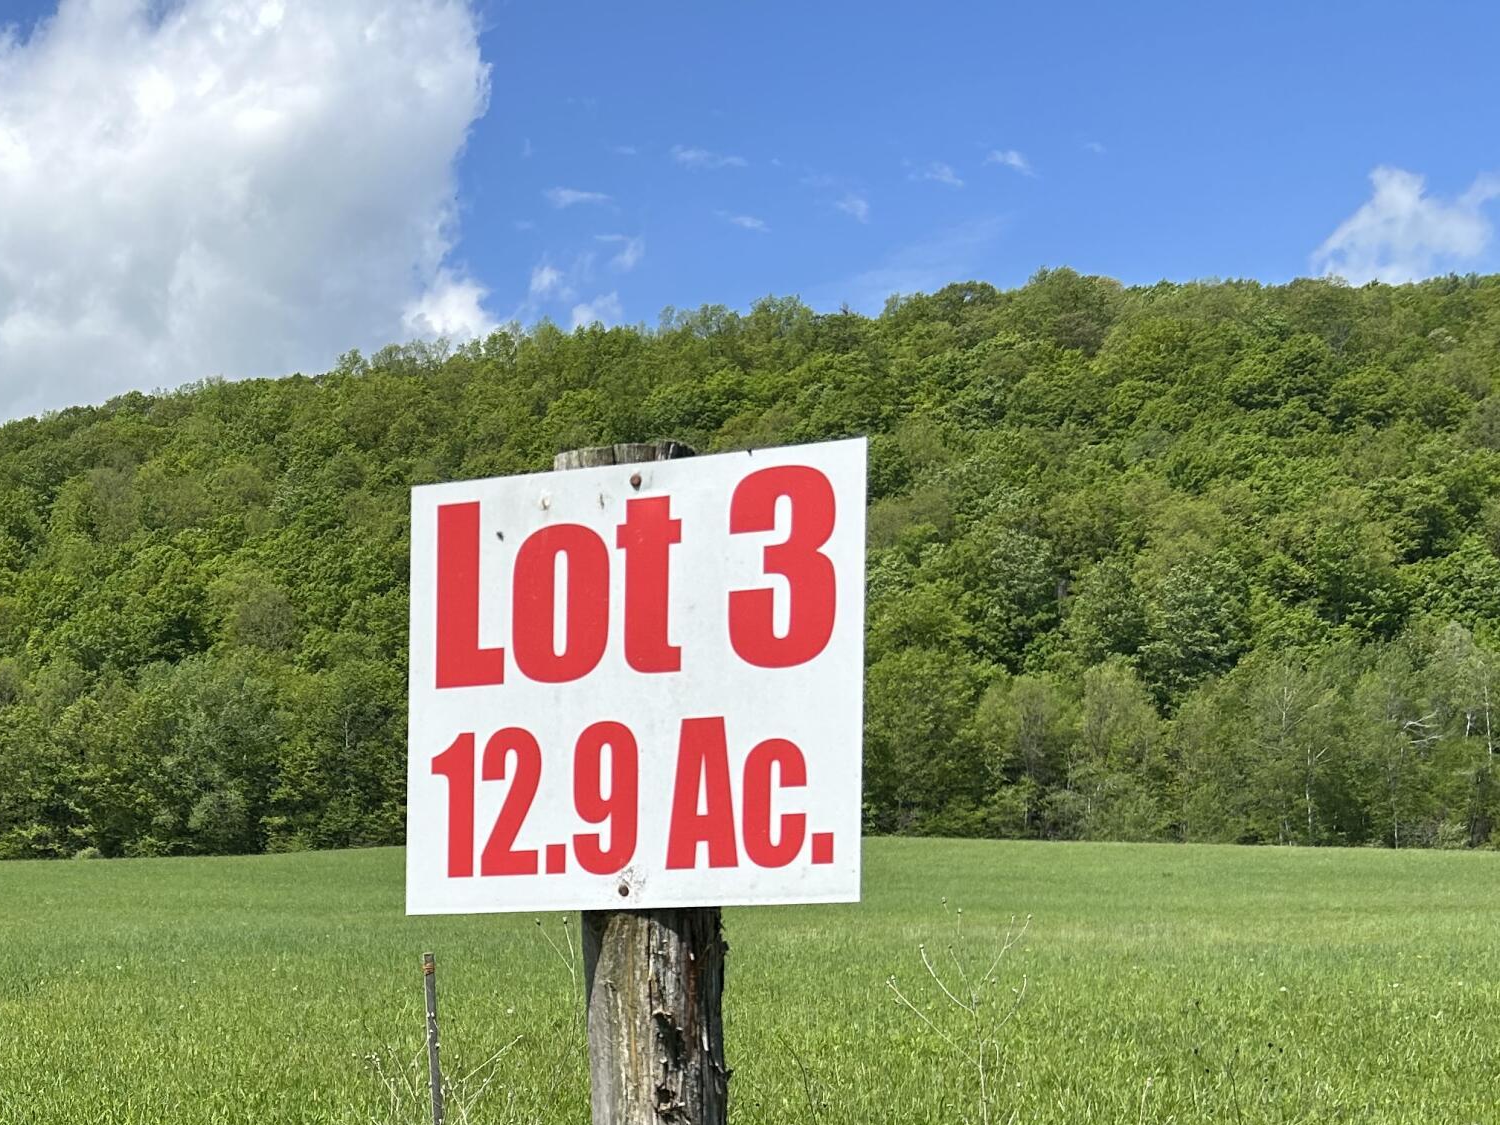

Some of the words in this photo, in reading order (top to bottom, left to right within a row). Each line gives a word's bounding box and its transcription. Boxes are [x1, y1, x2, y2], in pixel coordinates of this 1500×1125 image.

[435, 495, 683, 689] Lot
[728, 464, 837, 669] 3
[431, 720, 639, 878] 12.9
[665, 716, 835, 870] Ac.
